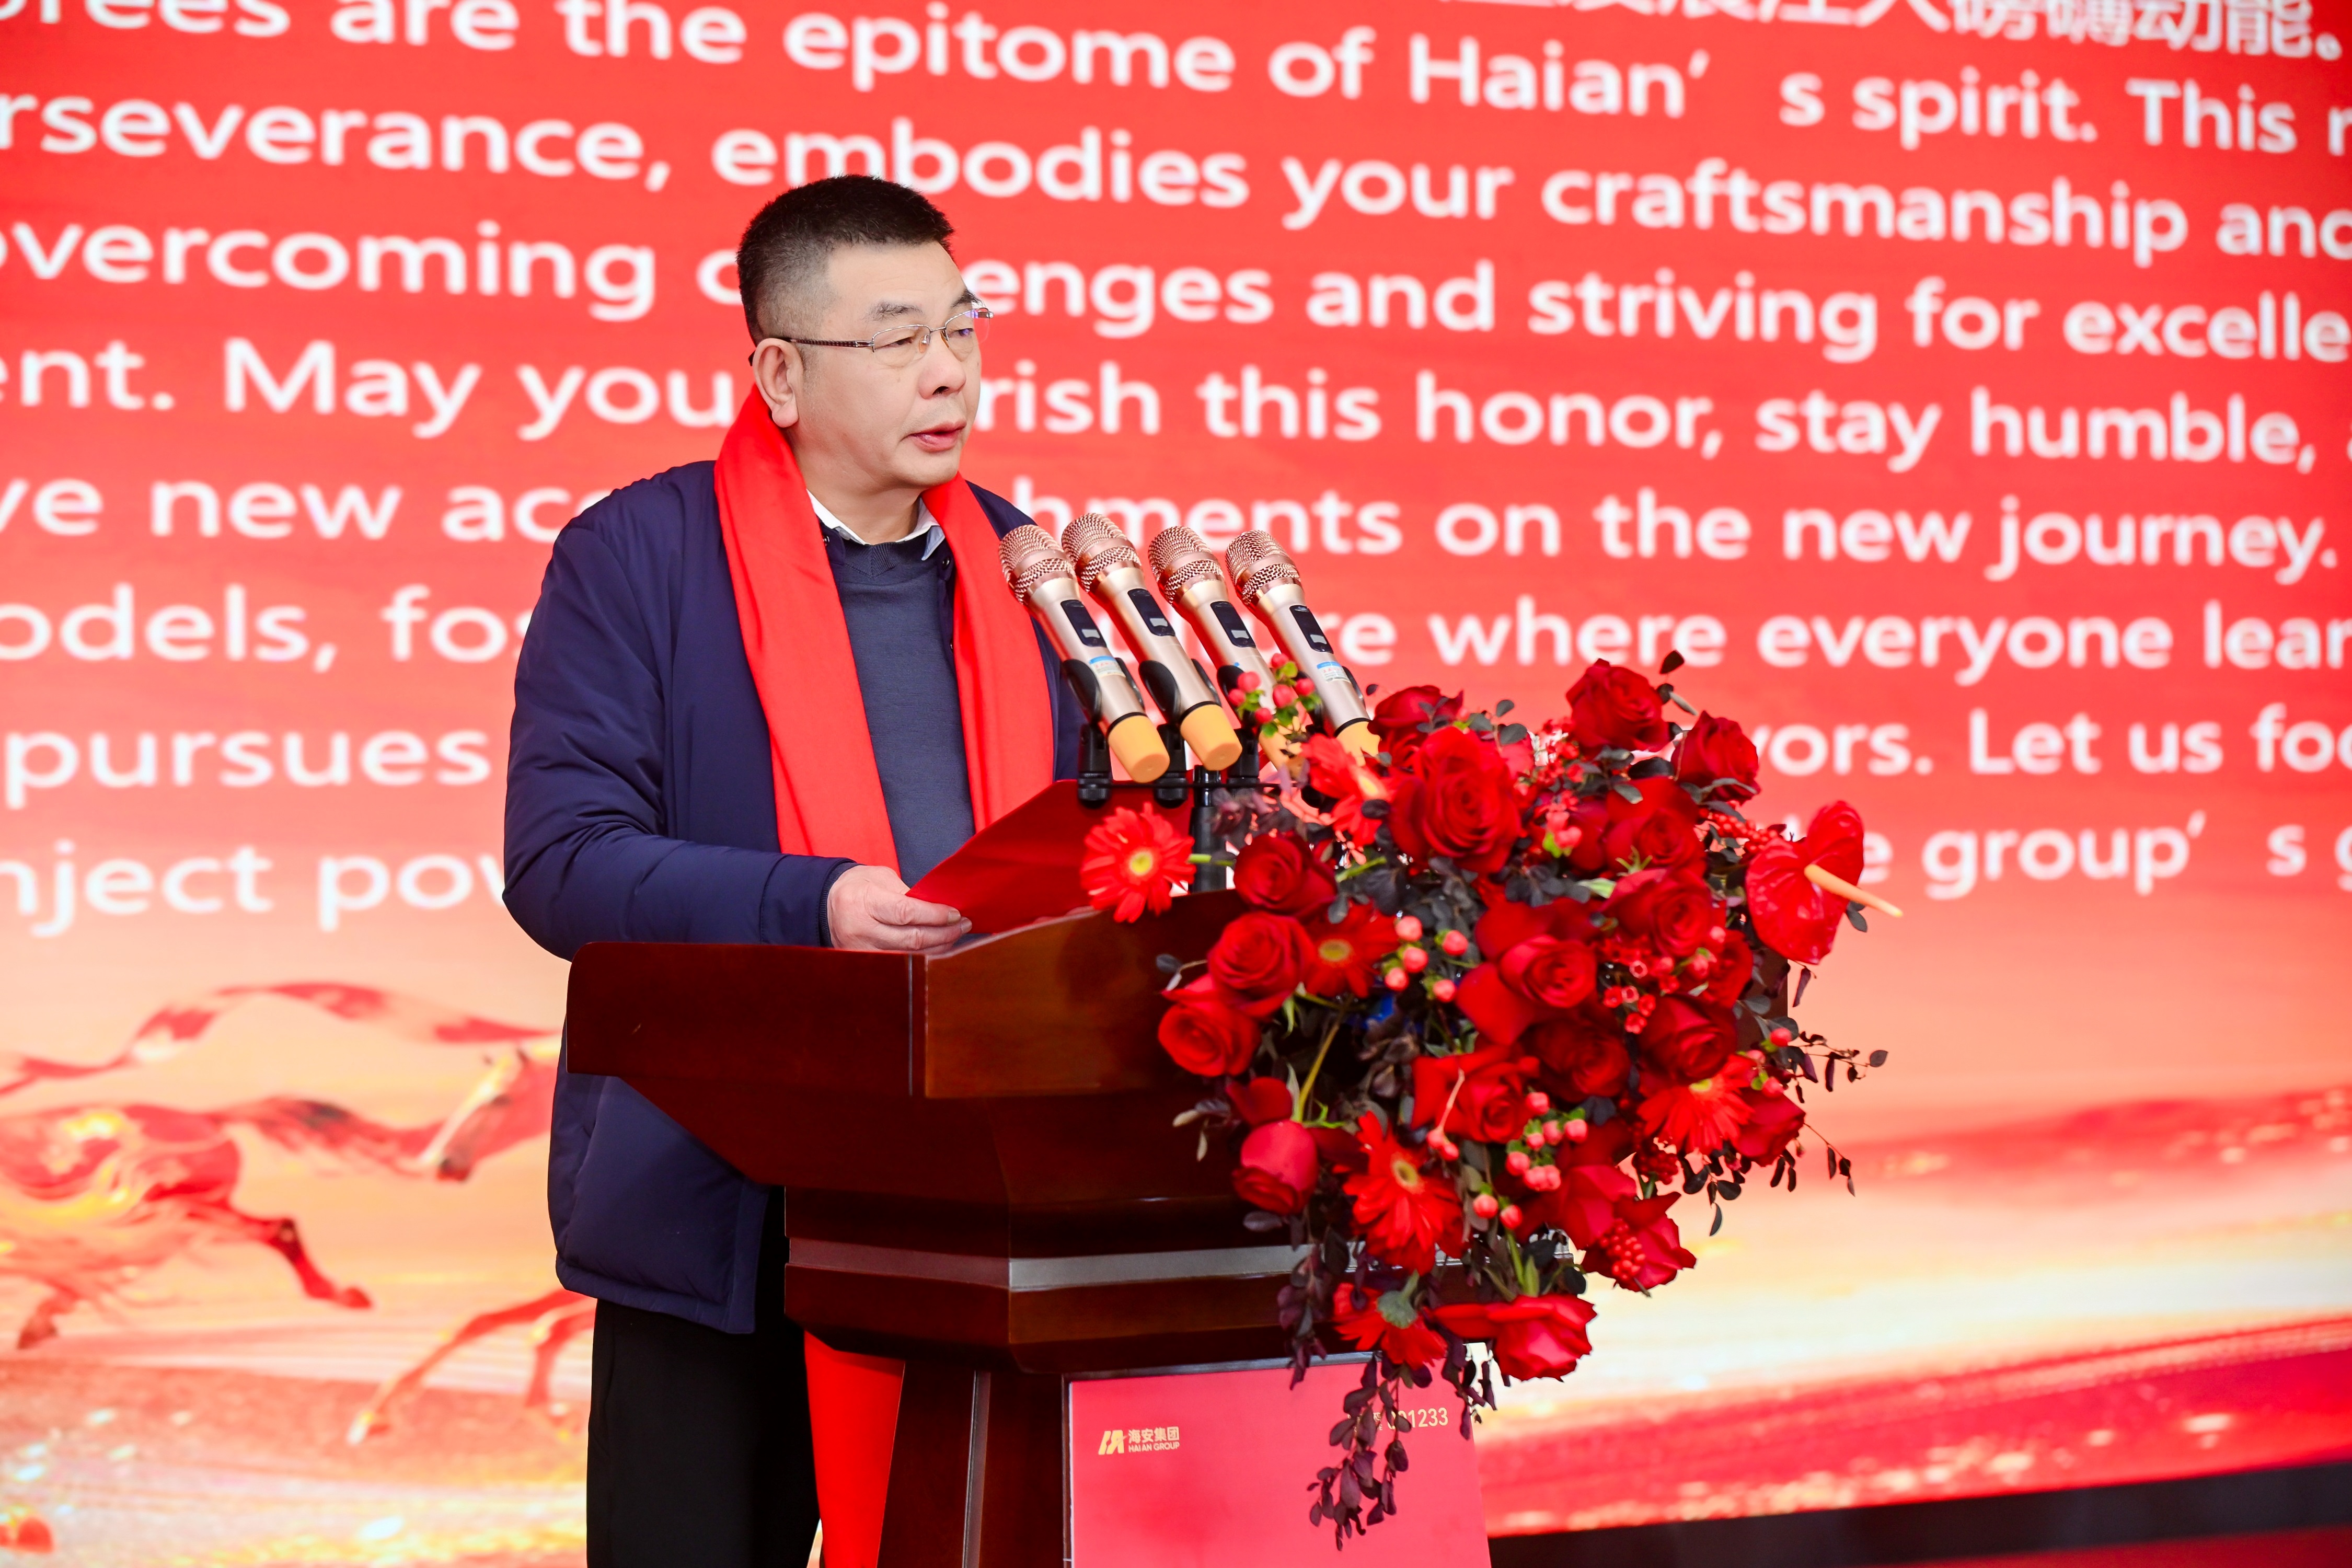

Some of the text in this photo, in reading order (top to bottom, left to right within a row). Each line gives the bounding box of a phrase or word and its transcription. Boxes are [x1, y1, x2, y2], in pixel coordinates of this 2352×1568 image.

[330, 0, 520, 51] are
[555, 0, 747, 65] the
[782, 1, 1236, 93] epitome
[1267, 25, 1376, 100] of
[1852, 65, 2098, 151] spirit.
[2125, 78, 2297, 154] This
[711, 117, 1250, 209] embodies
[1281, 156, 1515, 231] your
[1540, 157, 2189, 269] craftsmanship
[0, 220, 656, 322] vercoming
[1305, 259, 1495, 332] and
[1527, 267, 1878, 364] striving
[1905, 275, 2040, 351] for
[2062, 291, 2352, 363] excelle
[0, 340, 175, 412] nt.
[224, 337, 482, 440] May
[516, 364, 736, 442] you
[1196, 364, 1382, 442] this
[1415, 369, 1723, 459] honor,
[1755, 389, 1942, 474] stay
[1970, 386, 2316, 474] humble,
[150, 480, 403, 540] new
[1434, 502, 1561, 557] on
[1592, 487, 1751, 561] the
[1782, 508, 1972, 563] new
[1985, 494, 2337, 586] journey.
[1427, 594, 1727, 668] where
[1756, 615, 2174, 687] everyone
[4, 730, 493, 811] pursues
[1968, 708, 2101, 775] Let
[2128, 721, 2224, 774] us
[1128, 1426, 1180, 1444] 海安集团
[1153, 1441, 1180, 1451] GROUP
